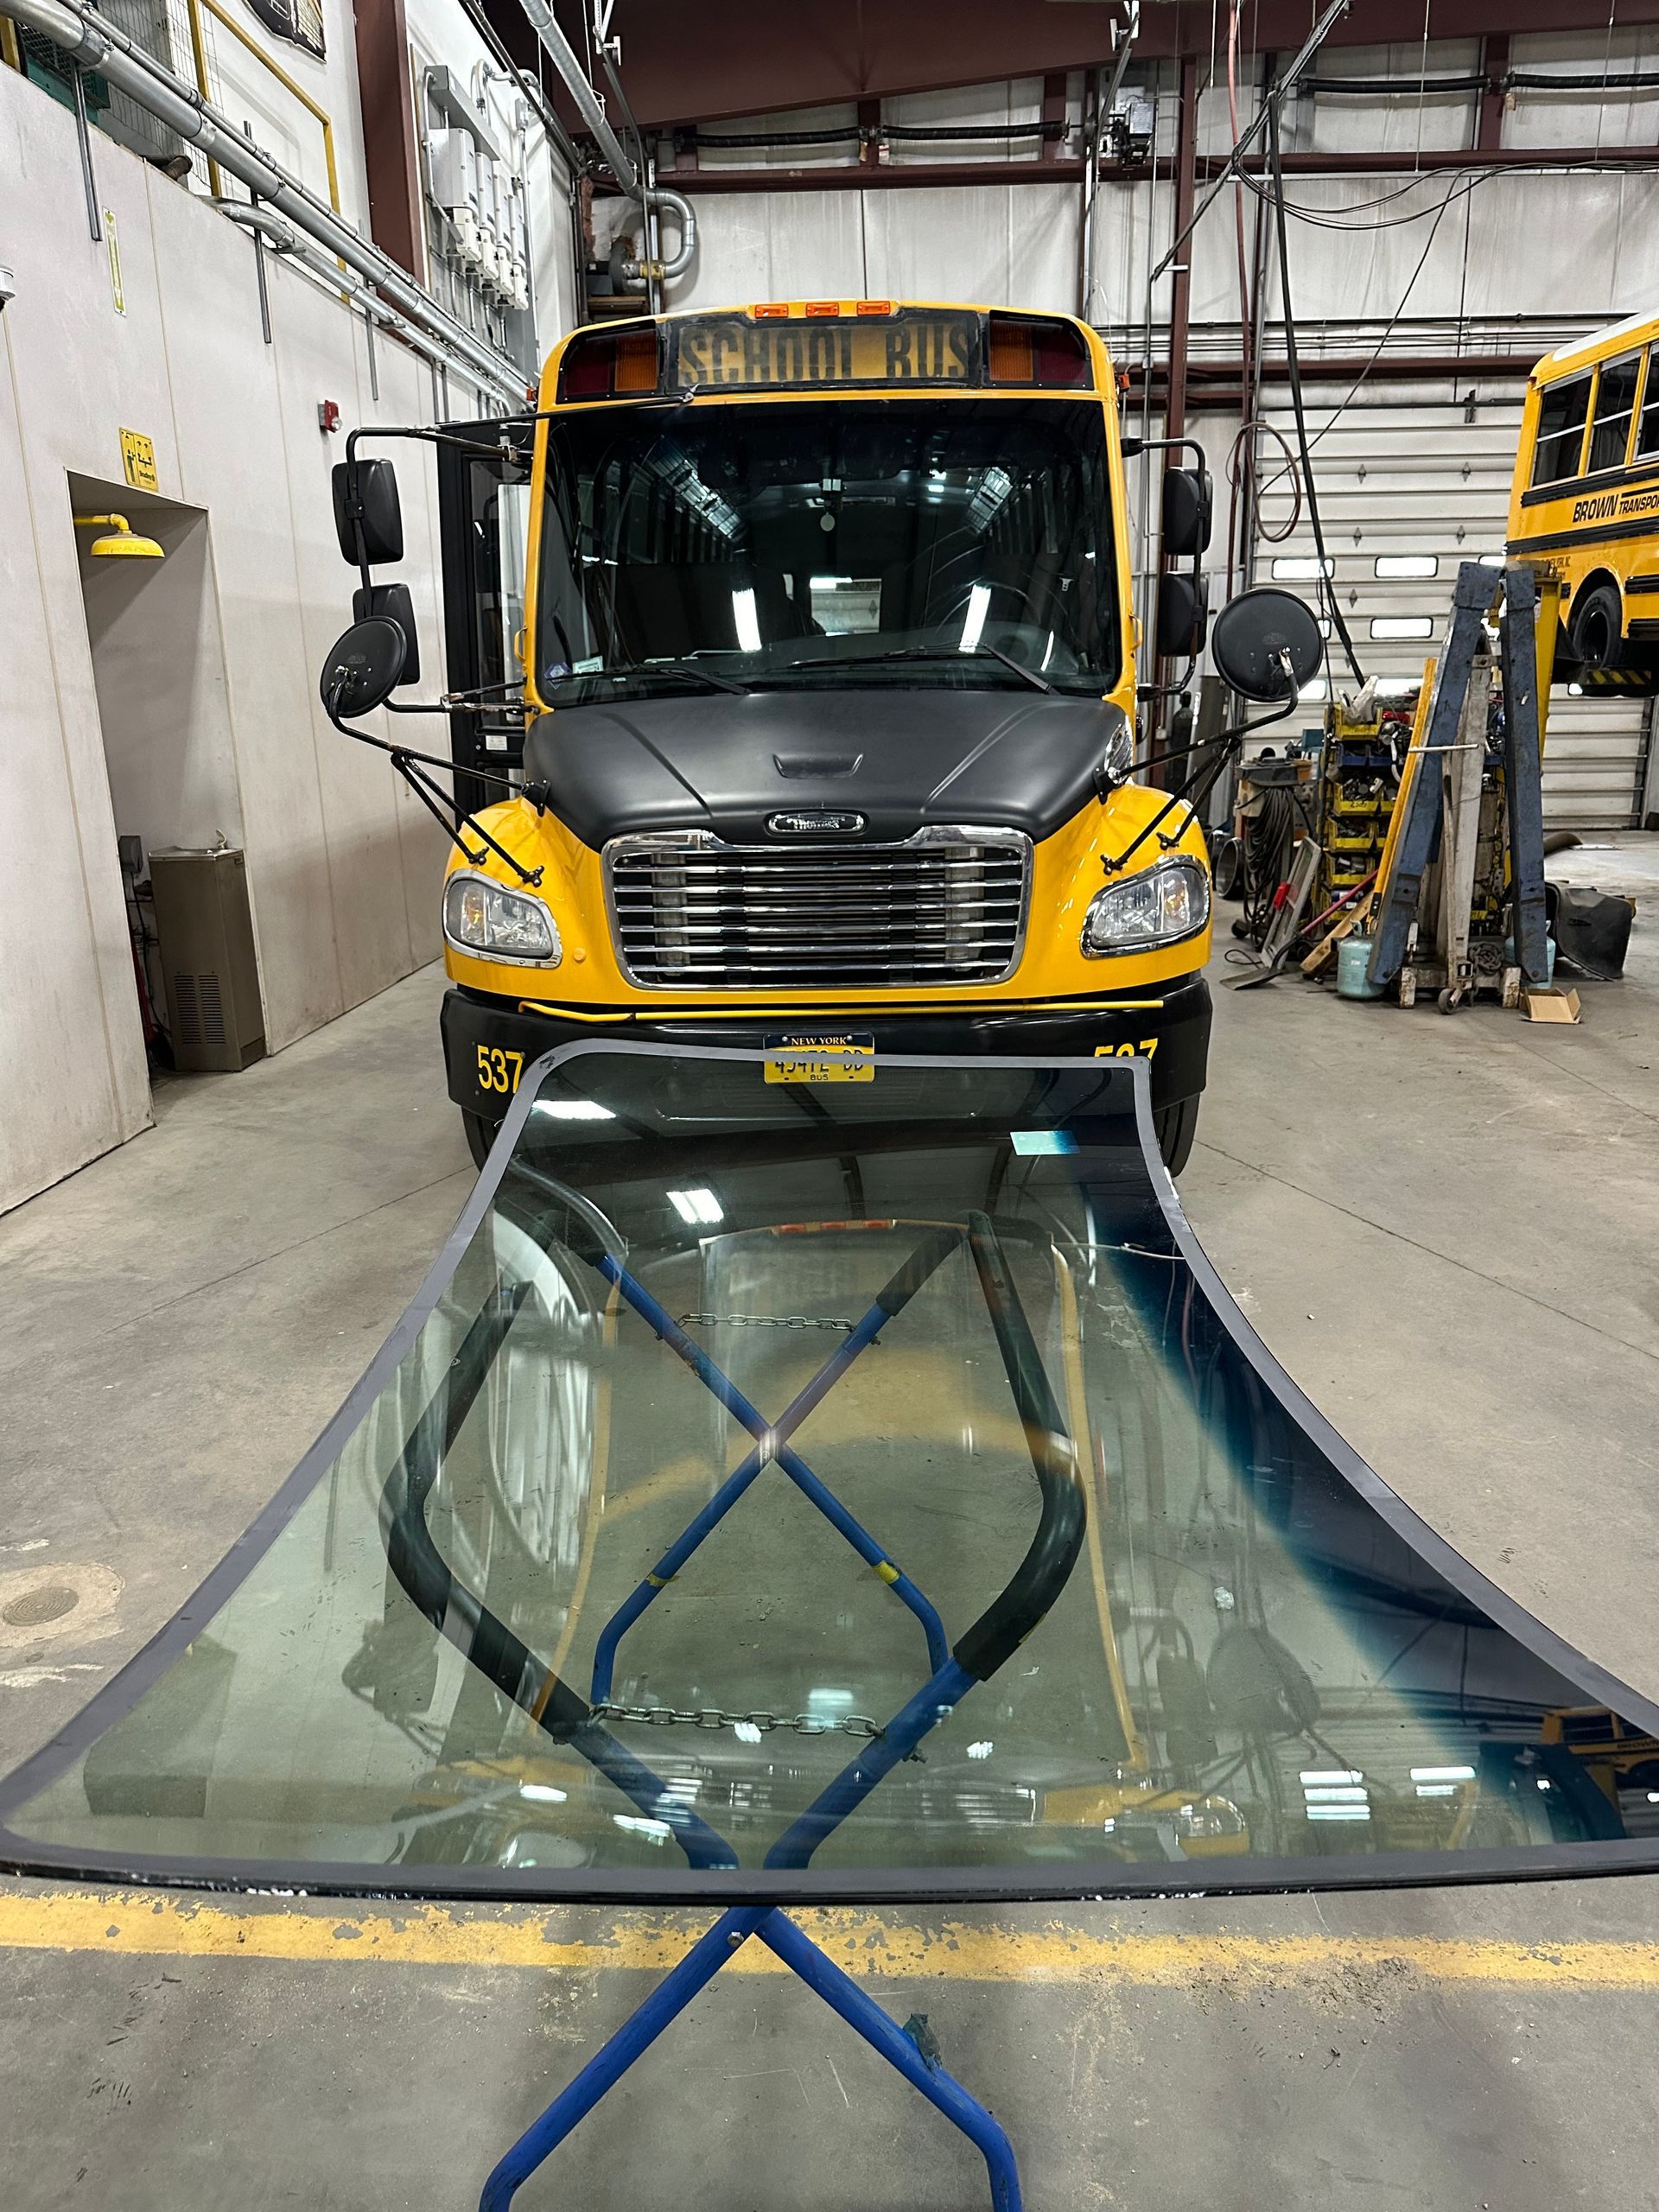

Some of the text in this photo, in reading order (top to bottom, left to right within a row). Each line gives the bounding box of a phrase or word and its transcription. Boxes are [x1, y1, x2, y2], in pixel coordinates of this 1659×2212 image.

[680, 319, 969, 385] SCHOOL BUS
[1572, 493, 1659, 523] BROWN TRANSPO
[477, 1045, 524, 1094] 537
